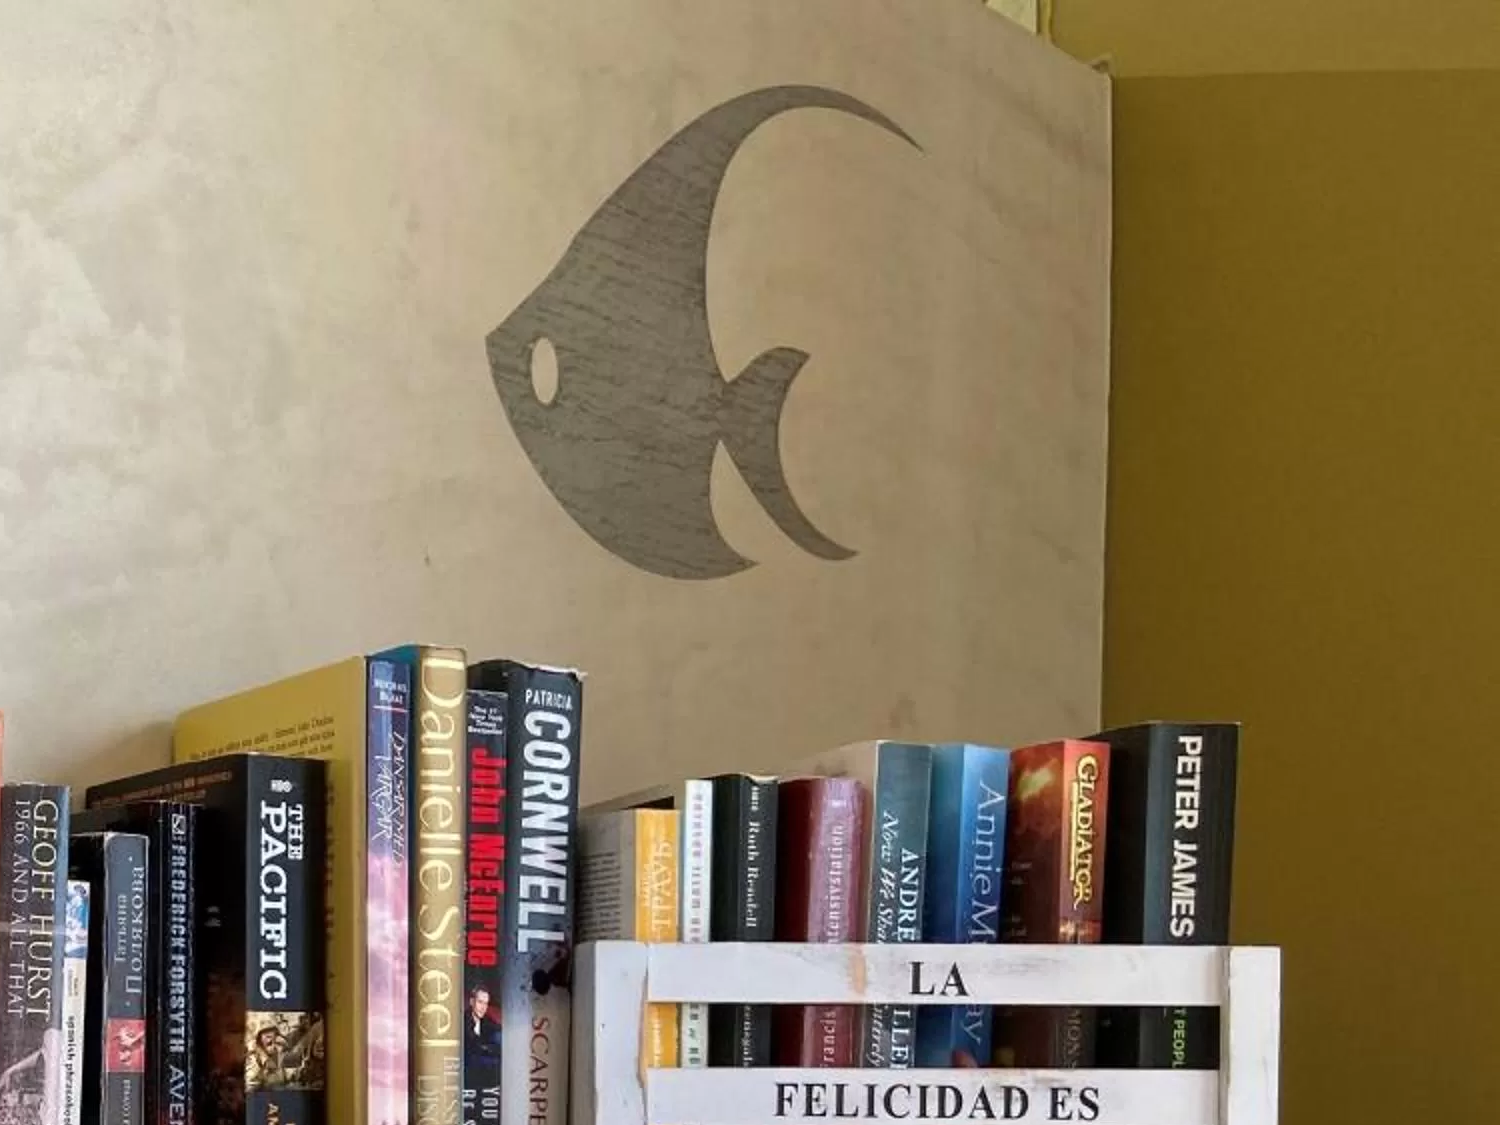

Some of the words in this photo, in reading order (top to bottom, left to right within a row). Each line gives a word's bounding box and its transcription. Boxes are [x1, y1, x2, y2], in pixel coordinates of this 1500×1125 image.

[525, 689, 572, 711] PATRICIA
[13, 800, 31, 845] 1966
[419, 658, 465, 895] Danielle
[470, 746, 507, 825] John
[1173, 735, 1204, 829] PETER
[11, 853, 29, 904] AND
[30, 800, 59, 902] GEOFF
[288, 803, 304, 860] THE
[517, 711, 571, 953] CORNWELL
[880, 811, 900, 864] Now
[969, 781, 1007, 896] Annie
[9, 911, 27, 951] ALL
[124, 866, 146, 995] Полякова
[170, 843, 188, 948] FREDERICK
[259, 800, 288, 1000] PACIFIC
[467, 832, 506, 968] McEnroe
[827, 824, 846, 945] tensivstation
[875, 903, 894, 945] Sha
[896, 847, 920, 943] ANDRE
[1169, 839, 1199, 938] JAMES
[7, 959, 25, 1019] THAT
[25, 914, 55, 1022] HURST
[169, 953, 187, 1053] FORSYTH
[417, 904, 462, 1047] Steel
[908, 961, 970, 997] LA
[819, 1009, 838, 1063] rancis
[1171, 1019, 1187, 1069] PEOPL
[481, 1086, 501, 1119] YOU
[774, 1082, 1030, 1120] FELICIDAD
[1047, 1086, 1102, 1122] ES
